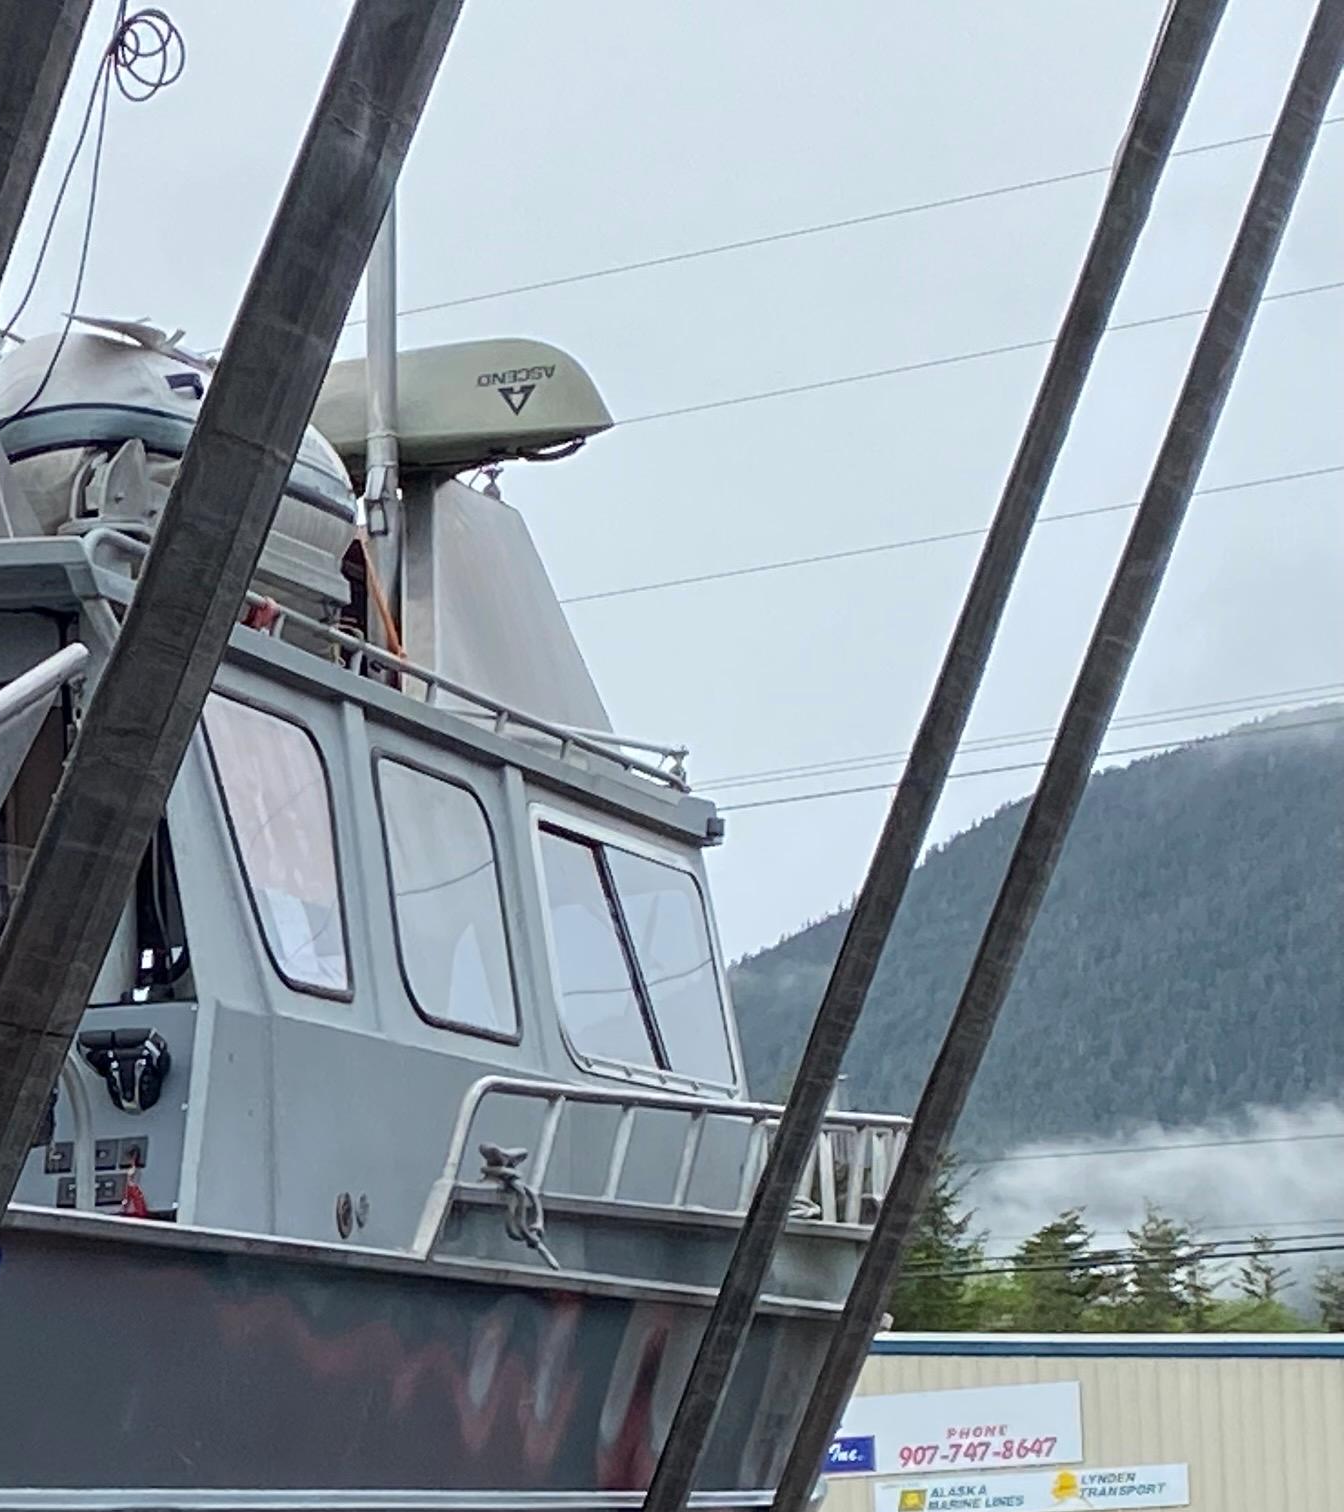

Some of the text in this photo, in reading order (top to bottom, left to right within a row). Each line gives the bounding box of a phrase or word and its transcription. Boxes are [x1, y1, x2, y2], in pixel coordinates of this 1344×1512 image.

[477, 364, 556, 387] ASCEND
[946, 1424, 1009, 1439] PHONE
[828, 1442, 865, 1463] Inc.
[898, 1437, 1058, 1468] 907-747-8647
[929, 1484, 988, 1498] ALASKA
[1078, 1483, 1167, 1498] TRANSPORT
